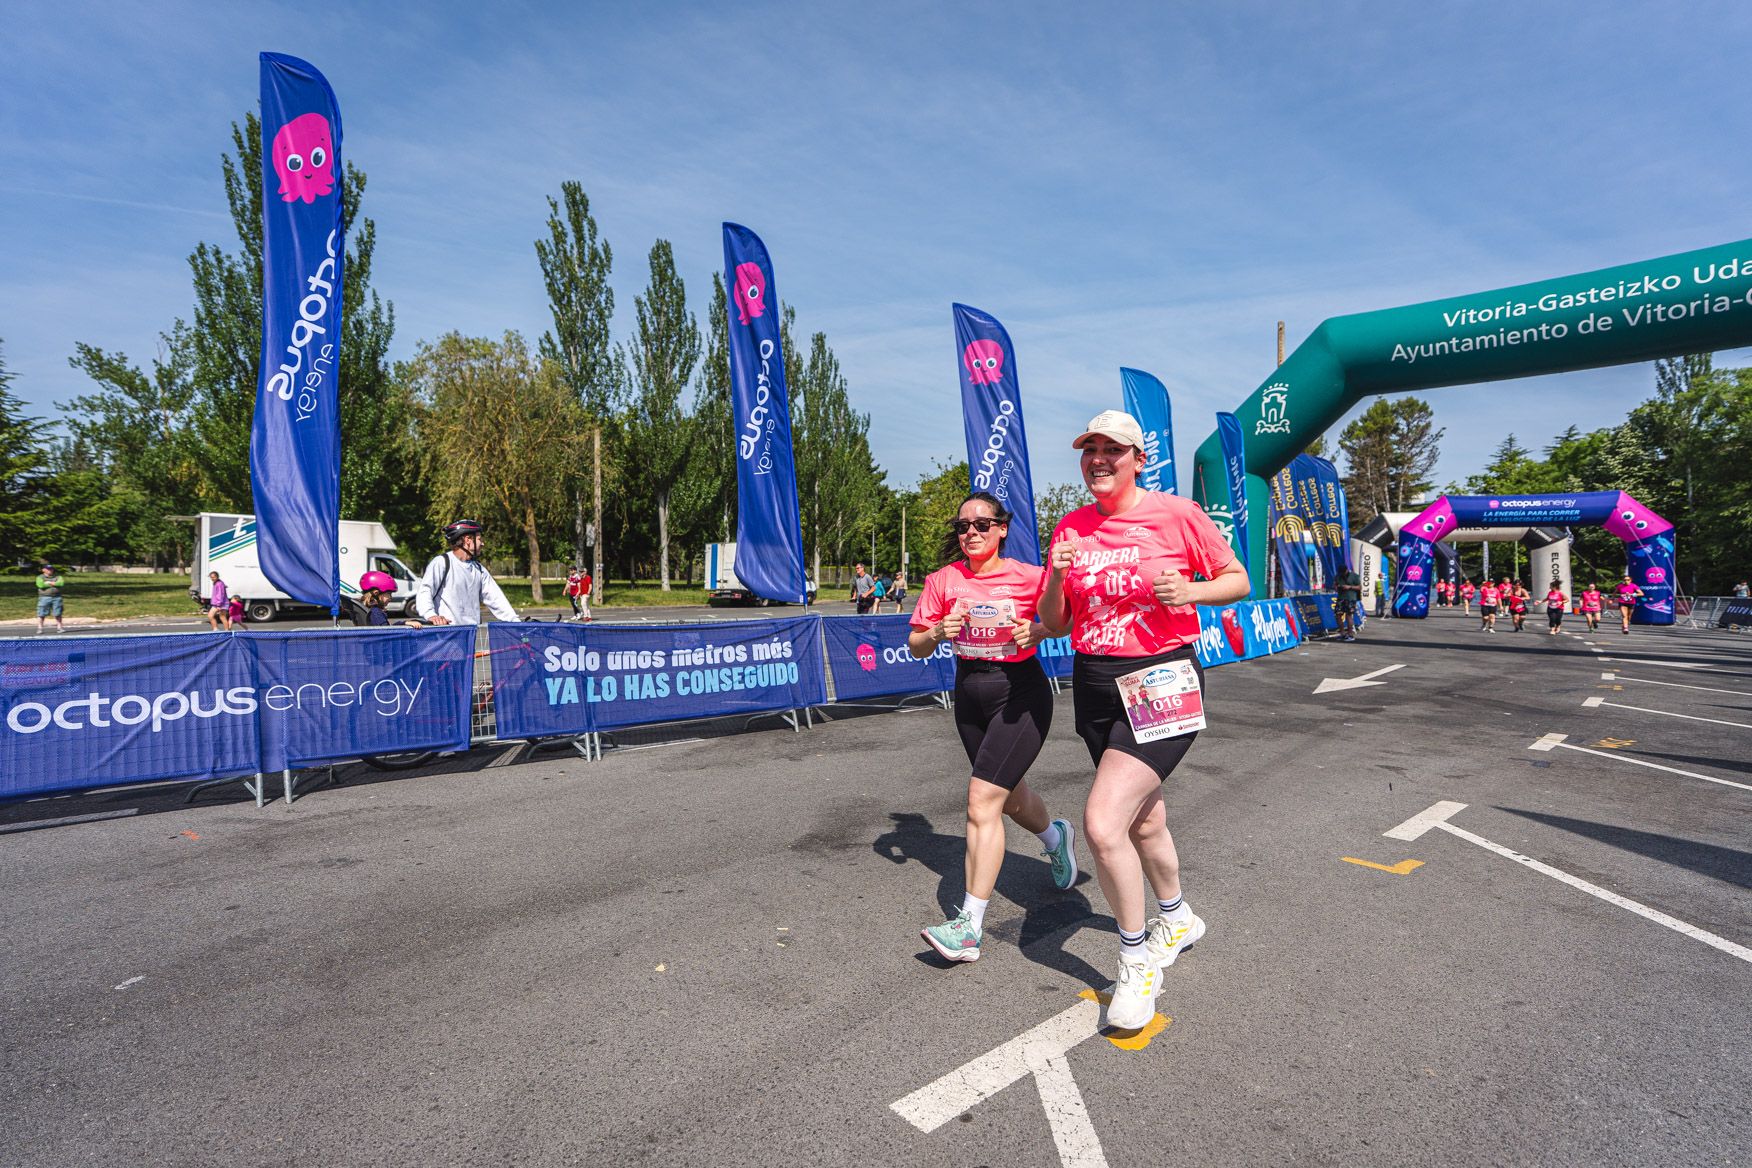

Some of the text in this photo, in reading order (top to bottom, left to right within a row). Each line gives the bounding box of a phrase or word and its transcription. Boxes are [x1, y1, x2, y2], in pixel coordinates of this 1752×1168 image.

[1443, 273, 1681, 328] Vitoria-Gasteizko
[1390, 322, 1567, 364] Ayuntamiento
[1578, 312, 1613, 335] de
[1502, 499, 1542, 508] octopus
[1363, 554, 1371, 597] EL CORREO
[1551, 552, 1560, 580] EL COR
[971, 628, 996, 637] 016
[544, 636, 792, 672] Solo unos metros más
[883, 642, 954, 666] octus
[545, 661, 799, 706] YA LO HAS CONSEGUIDO
[6, 677, 424, 733] octopus energy
[1153, 695, 1183, 712] 016
[1144, 728, 1170, 738] OYSHO
